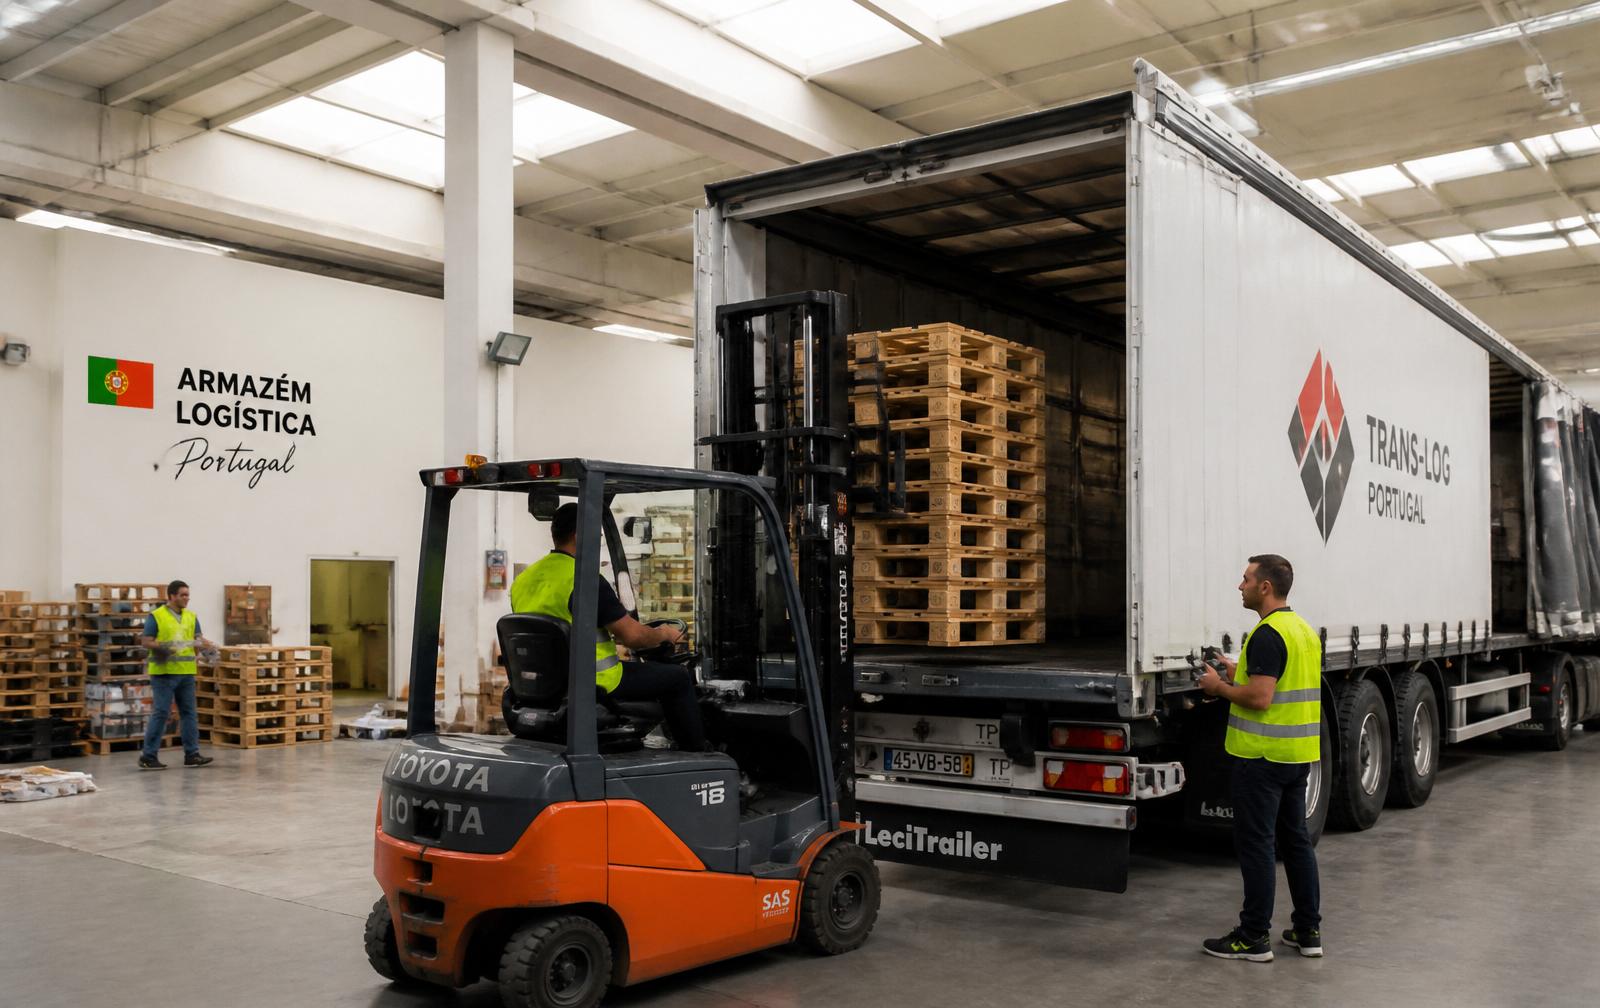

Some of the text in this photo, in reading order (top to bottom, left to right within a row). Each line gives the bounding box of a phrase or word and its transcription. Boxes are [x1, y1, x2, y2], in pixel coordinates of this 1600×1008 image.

[177, 367, 311, 404] ARMAZÉM
[176, 400, 316, 436] LOGÍSTICA
[171, 437, 296, 489] Portugal
[1366, 414, 1450, 486] TRANS-LOG
[1368, 481, 1426, 525] PORTUGAL
[391, 752, 490, 792] TOYOTA
[695, 787, 725, 806] 18
[865, 820, 1003, 861] LeciTrailer
[762, 889, 790, 910] SAS
